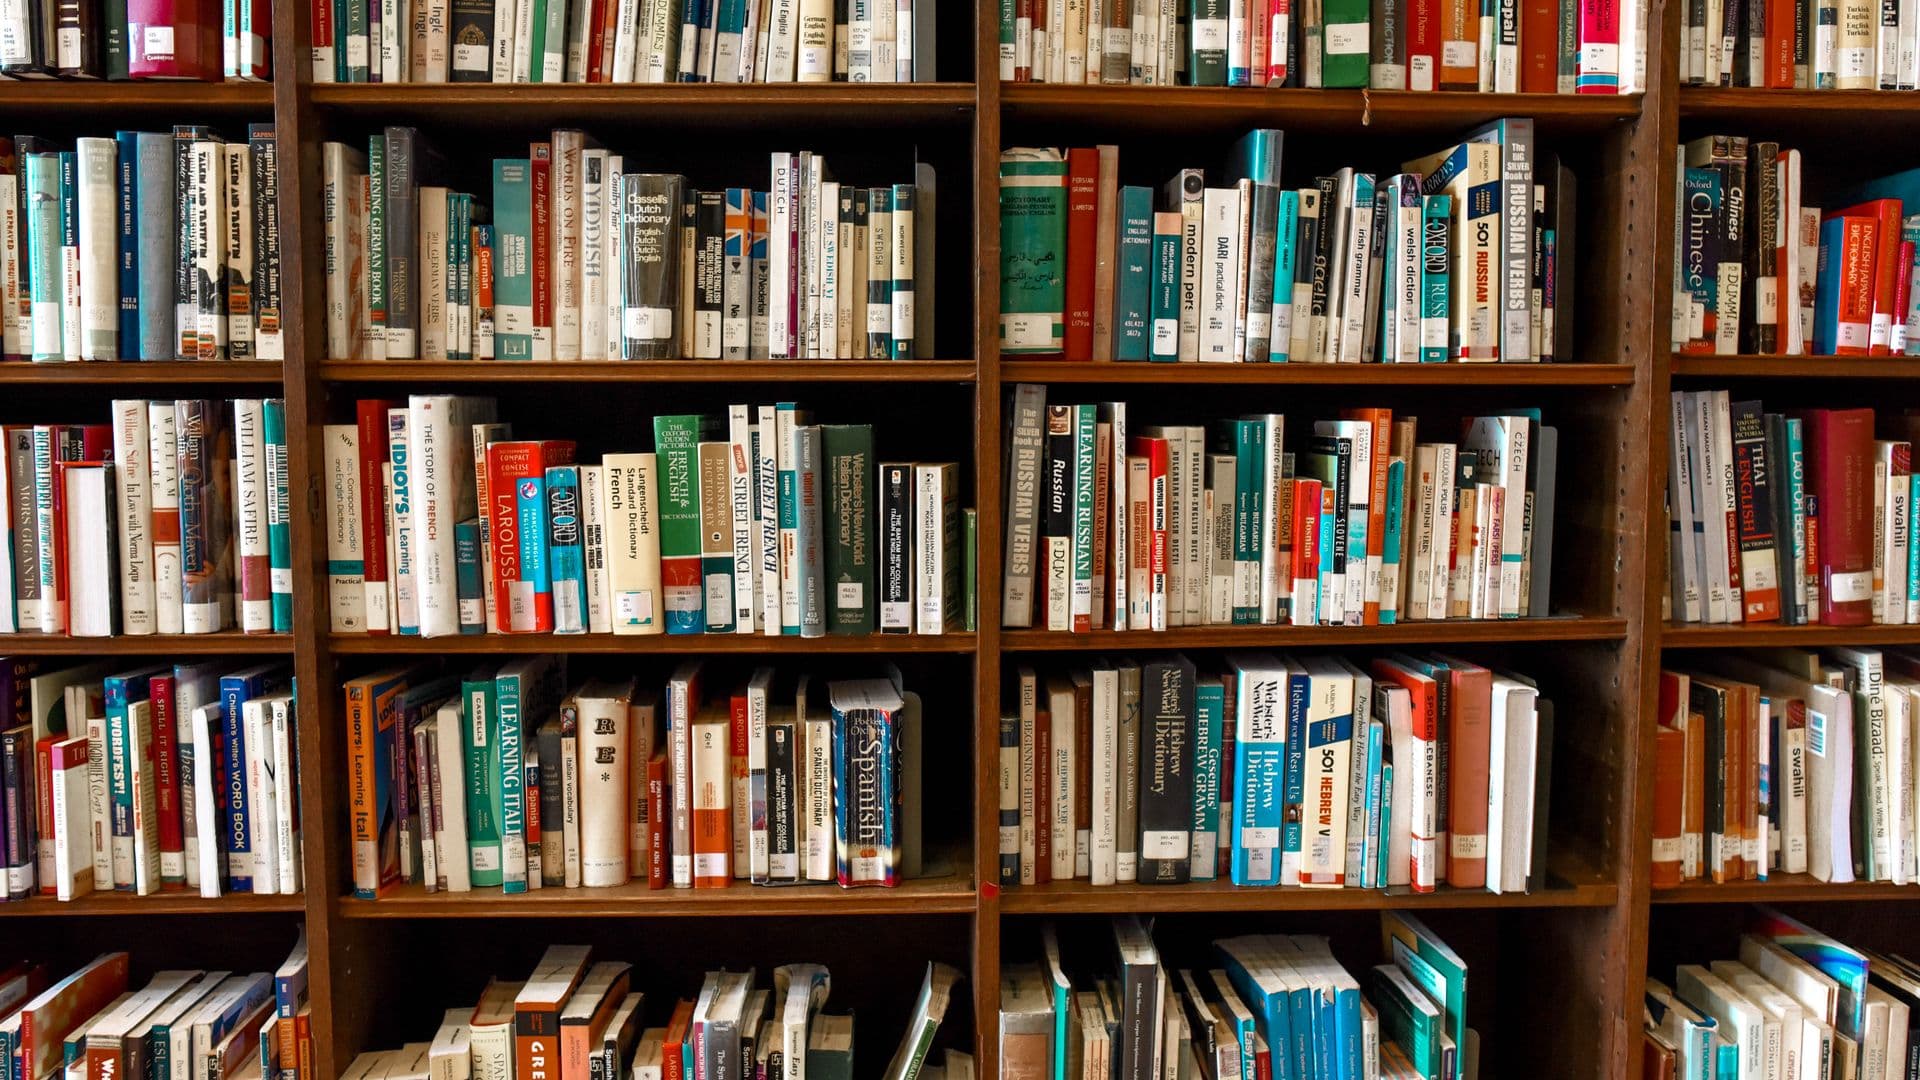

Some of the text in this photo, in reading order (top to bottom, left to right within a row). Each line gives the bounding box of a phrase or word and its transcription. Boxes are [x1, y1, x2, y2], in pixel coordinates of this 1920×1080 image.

[1512, 144, 1525, 152] The
[1513, 153, 1524, 161] BIG
[777, 168, 785, 215] DUTCH
[1504, 172, 1532, 180] Book of
[1685, 181, 1711, 189] Oxford
[325, 182, 335, 275] Yiddish English
[370, 153, 382, 305] LEARNING GERMAN BOOK
[563, 149, 576, 266] WORDS ON FIRE
[585, 188, 600, 277] YIDDISH
[624, 215, 670, 225] Dictionary
[634, 205, 661, 213] Dutch
[1510, 184, 1525, 253] RUSSIAN
[1729, 187, 1743, 241] Chinese
[634, 255, 661, 263] English
[875, 228, 883, 265] SWEDISH
[1187, 224, 1197, 278] modern
[1216, 237, 1228, 293] DARI practical
[1354, 228, 1366, 297] irish grammar
[1407, 228, 1415, 262] welsh
[1424, 223, 1447, 272] OXFORD
[1476, 222, 1488, 303] 501 RUSSIAN
[1690, 192, 1713, 288] Chinese
[482, 251, 490, 290] German
[1311, 255, 1326, 316] gaelic
[1509, 259, 1525, 310] VERBS
[125, 408, 137, 447] William
[1017, 428, 1040, 436] SILVER
[1023, 409, 1036, 418] The
[1023, 418, 1034, 426] BIG
[241, 412, 257, 546] WILLIAM SAFIRE
[392, 444, 410, 514] IDIOT'S
[668, 451, 679, 503] ENGLISH
[677, 451, 689, 498] FRENCH
[853, 453, 864, 501] Webster's
[1513, 432, 1522, 472] CZECH
[1752, 445, 1766, 486] THAI
[424, 424, 437, 540] THE STORY OF FRENCH
[611, 468, 621, 510] French
[638, 468, 649, 535] Langenscheidt
[735, 476, 747, 525] STREET
[838, 456, 852, 546] Italian Dictionary
[1015, 449, 1035, 519] RUSSIAN
[1053, 459, 1065, 513] Russian
[1077, 423, 1093, 571] LEARNING RUSSIAN
[1738, 460, 1754, 532] ENGLISH
[1792, 451, 1803, 508] LAO FOR
[550, 492, 577, 543] OXFORD
[627, 468, 637, 560] Standard Dictionary
[762, 457, 776, 573] STREET FRENCH
[1305, 517, 1315, 558] Bosnian
[1336, 518, 1345, 557] SLOVENE
[1725, 464, 1737, 568] KOREAN BEGINNERS
[1894, 495, 1905, 548] swahili
[399, 528, 410, 575] Learning
[498, 495, 515, 588] LAROUSSE
[1012, 522, 1032, 574] VERBS
[1155, 532, 1164, 574] dictionary
[1808, 520, 1816, 565] Mandarin
[1161, 669, 1171, 715] New World
[1170, 669, 1182, 714] Webster's
[1251, 680, 1264, 739] New World
[1264, 680, 1278, 739] Webster's
[1869, 671, 1882, 704] Diné
[157, 698, 169, 785] SPELL RIGHT
[475, 697, 483, 742] CASSELL'S
[500, 703, 520, 788] LEARNING
[854, 718, 882, 726] Pocket
[1023, 684, 1033, 781] Held BEGINNING
[1195, 708, 1209, 770] HEBREW
[1291, 684, 1303, 773] Hebrew Rest
[110, 715, 126, 795] WORDFEST!
[228, 693, 246, 849] Children's WORD BOOK
[1150, 721, 1170, 795] Dictionary
[1169, 722, 1185, 777] Hebrew
[1425, 696, 1434, 798] SPOKEN LEBANESE
[1792, 747, 1803, 798] swahili
[181, 749, 194, 824] thesaurus
[354, 754, 364, 806] Learning
[566, 785, 574, 824] vocabulary
[814, 747, 822, 828] SPANISH DICTIONARY
[853, 740, 885, 840] Spanish
[1207, 748, 1219, 810] Gesenius'
[1262, 751, 1279, 812] Hebrew
[1319, 749, 1334, 826] 501 HEBREW
[528, 790, 537, 827] Spanish
[153, 1041, 166, 1063] ESL
[1244, 1031, 1255, 1057] Easy
